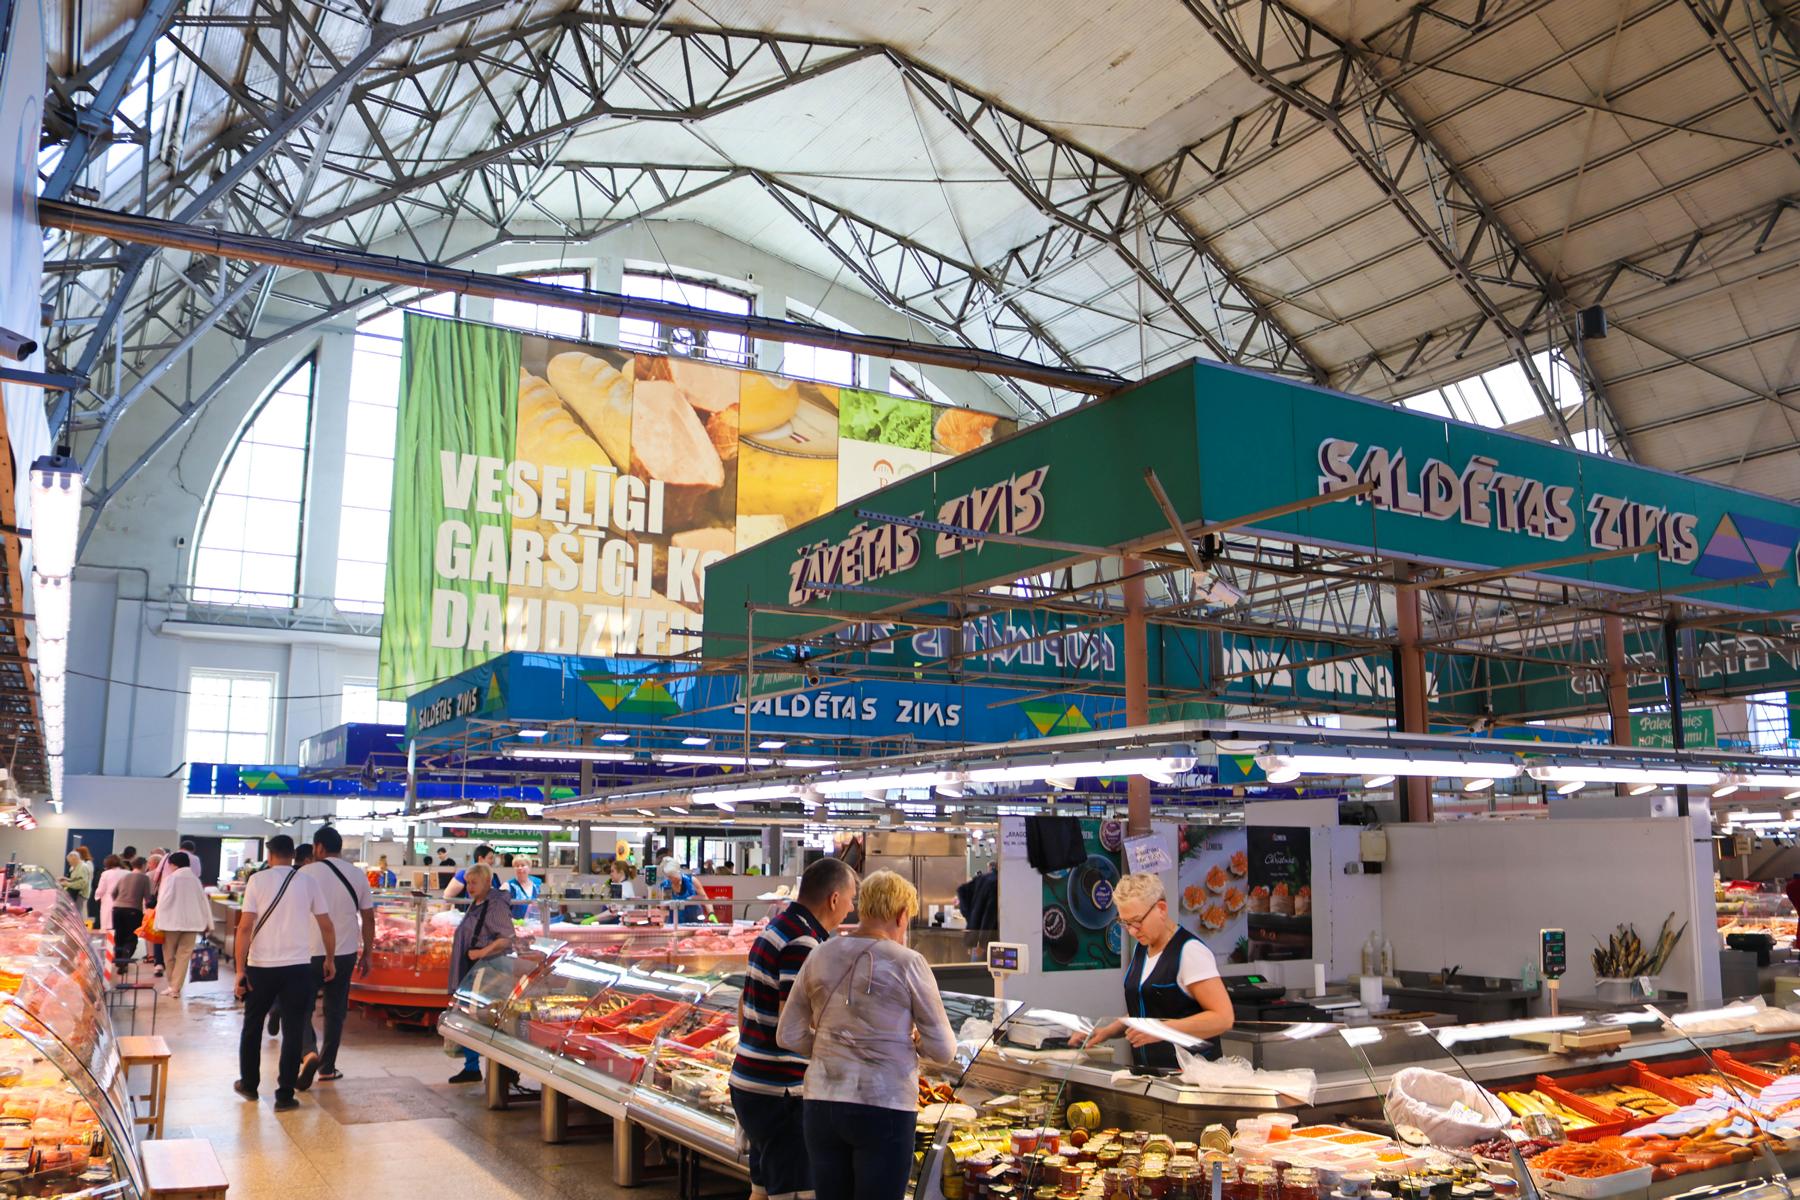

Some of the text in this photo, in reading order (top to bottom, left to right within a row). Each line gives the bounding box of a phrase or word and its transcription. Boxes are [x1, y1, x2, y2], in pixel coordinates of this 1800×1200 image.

[440, 450, 664, 534] VESELĪGI
[1318, 437, 1575, 541] SALDĒTAS
[1588, 494, 1699, 564] ZIVIS
[435, 521, 653, 599] GARŠĪGI
[788, 465, 1050, 607] ŽĀVĒTAS ZIVIS
[419, 687, 477, 730] SALDĒTAS ZIVIS
[734, 691, 878, 721] SALDĒTAS
